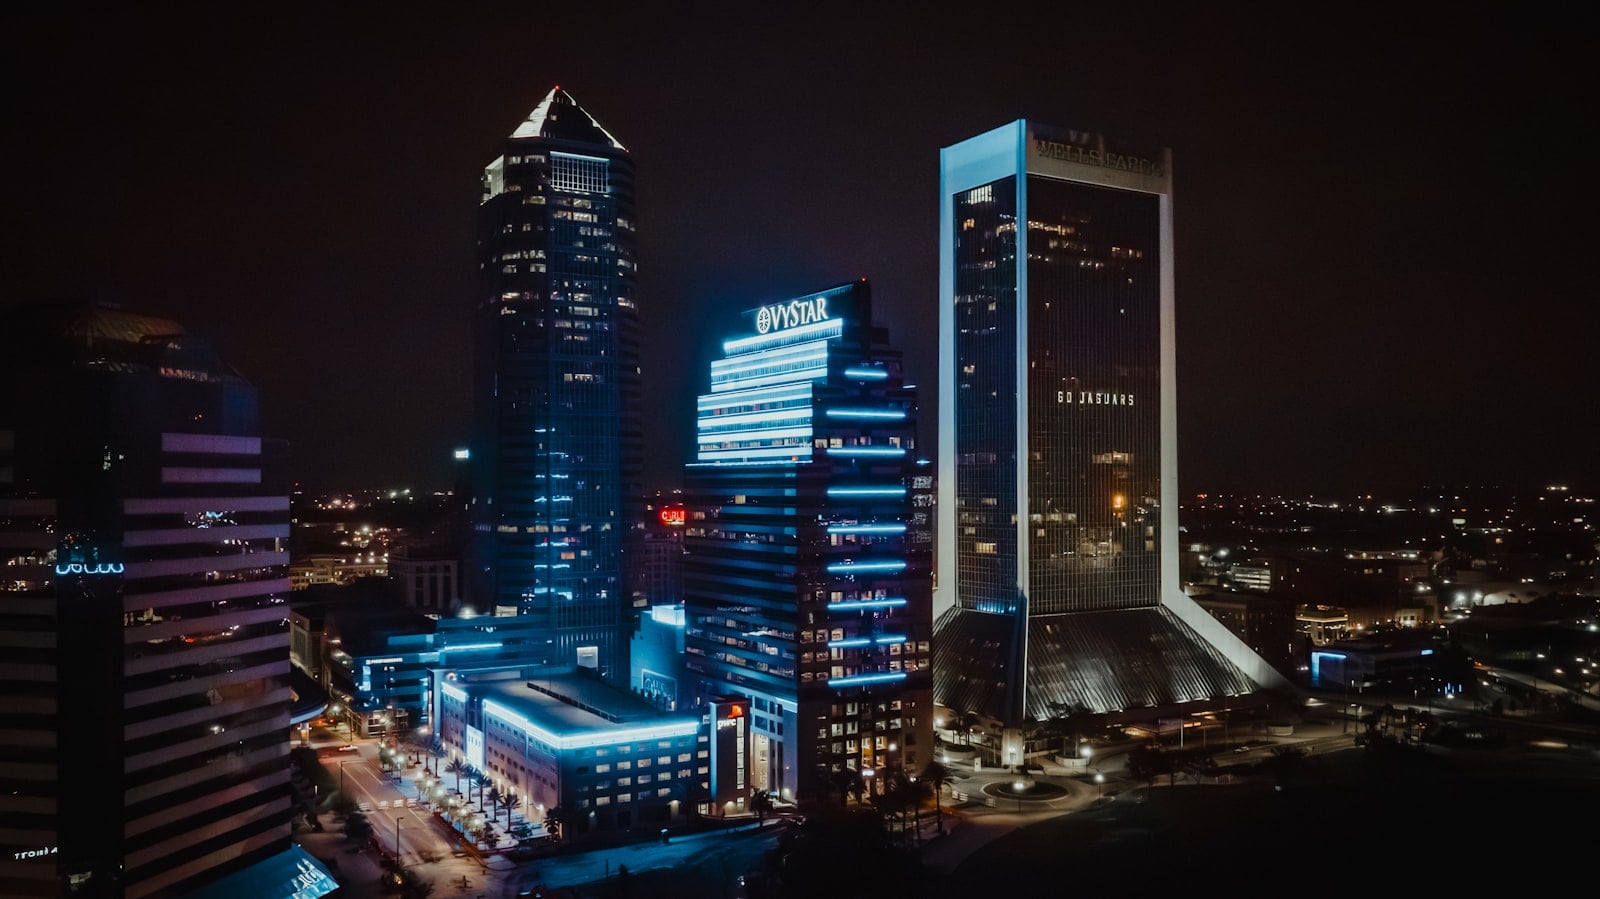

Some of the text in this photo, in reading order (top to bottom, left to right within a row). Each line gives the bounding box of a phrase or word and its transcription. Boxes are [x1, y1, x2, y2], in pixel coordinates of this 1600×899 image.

[1036, 141, 1101, 167] WELLS
[1057, 391, 1135, 406] GO JAGUARS
[717, 718, 737, 730] pwc
